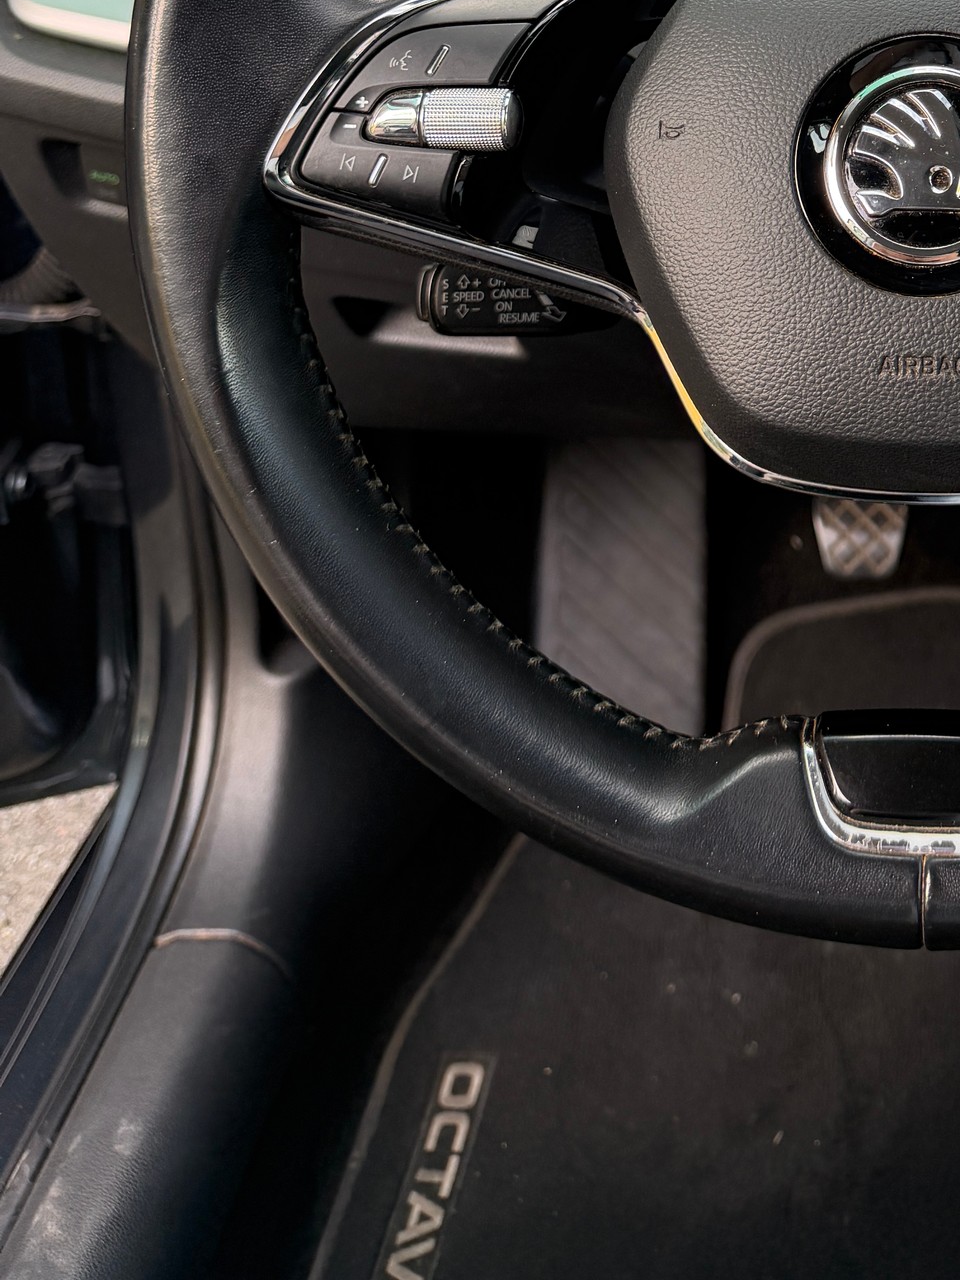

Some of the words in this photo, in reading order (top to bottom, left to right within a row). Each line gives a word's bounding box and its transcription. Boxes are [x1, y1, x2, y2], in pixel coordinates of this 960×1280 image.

[453, 290, 485, 301] SPEED
[492, 288, 532, 299] CANCEL
[496, 301, 513, 312] ON
[499, 312, 540, 323] RESUME
[386, 1061, 485, 1280] OCTAV
